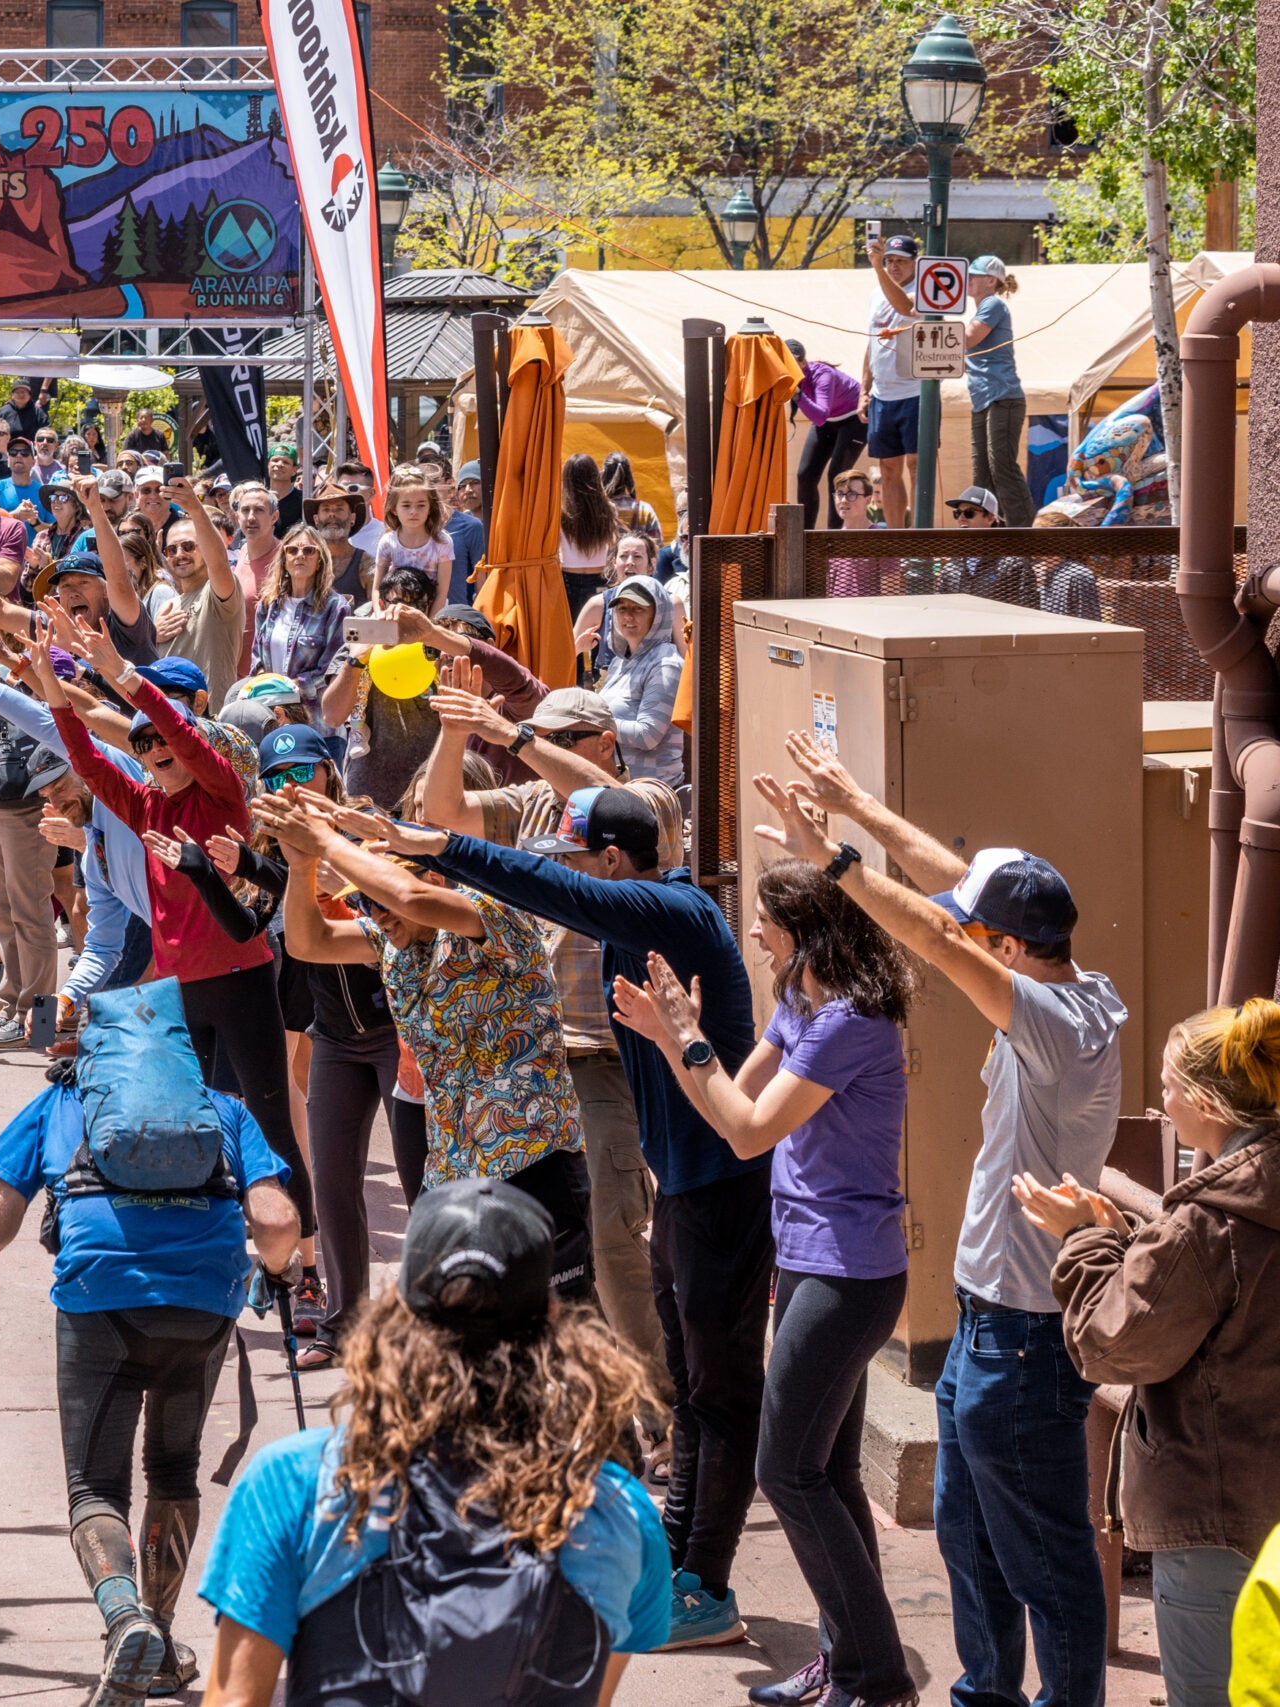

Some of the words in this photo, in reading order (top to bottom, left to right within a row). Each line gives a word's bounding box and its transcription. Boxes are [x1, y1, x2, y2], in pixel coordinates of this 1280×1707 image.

[20, 105, 156, 168] 250
[190, 276, 291, 293] ARAVAIPA
[197, 294, 284, 306] RUNNING
[915, 350, 961, 361] Restrooms
